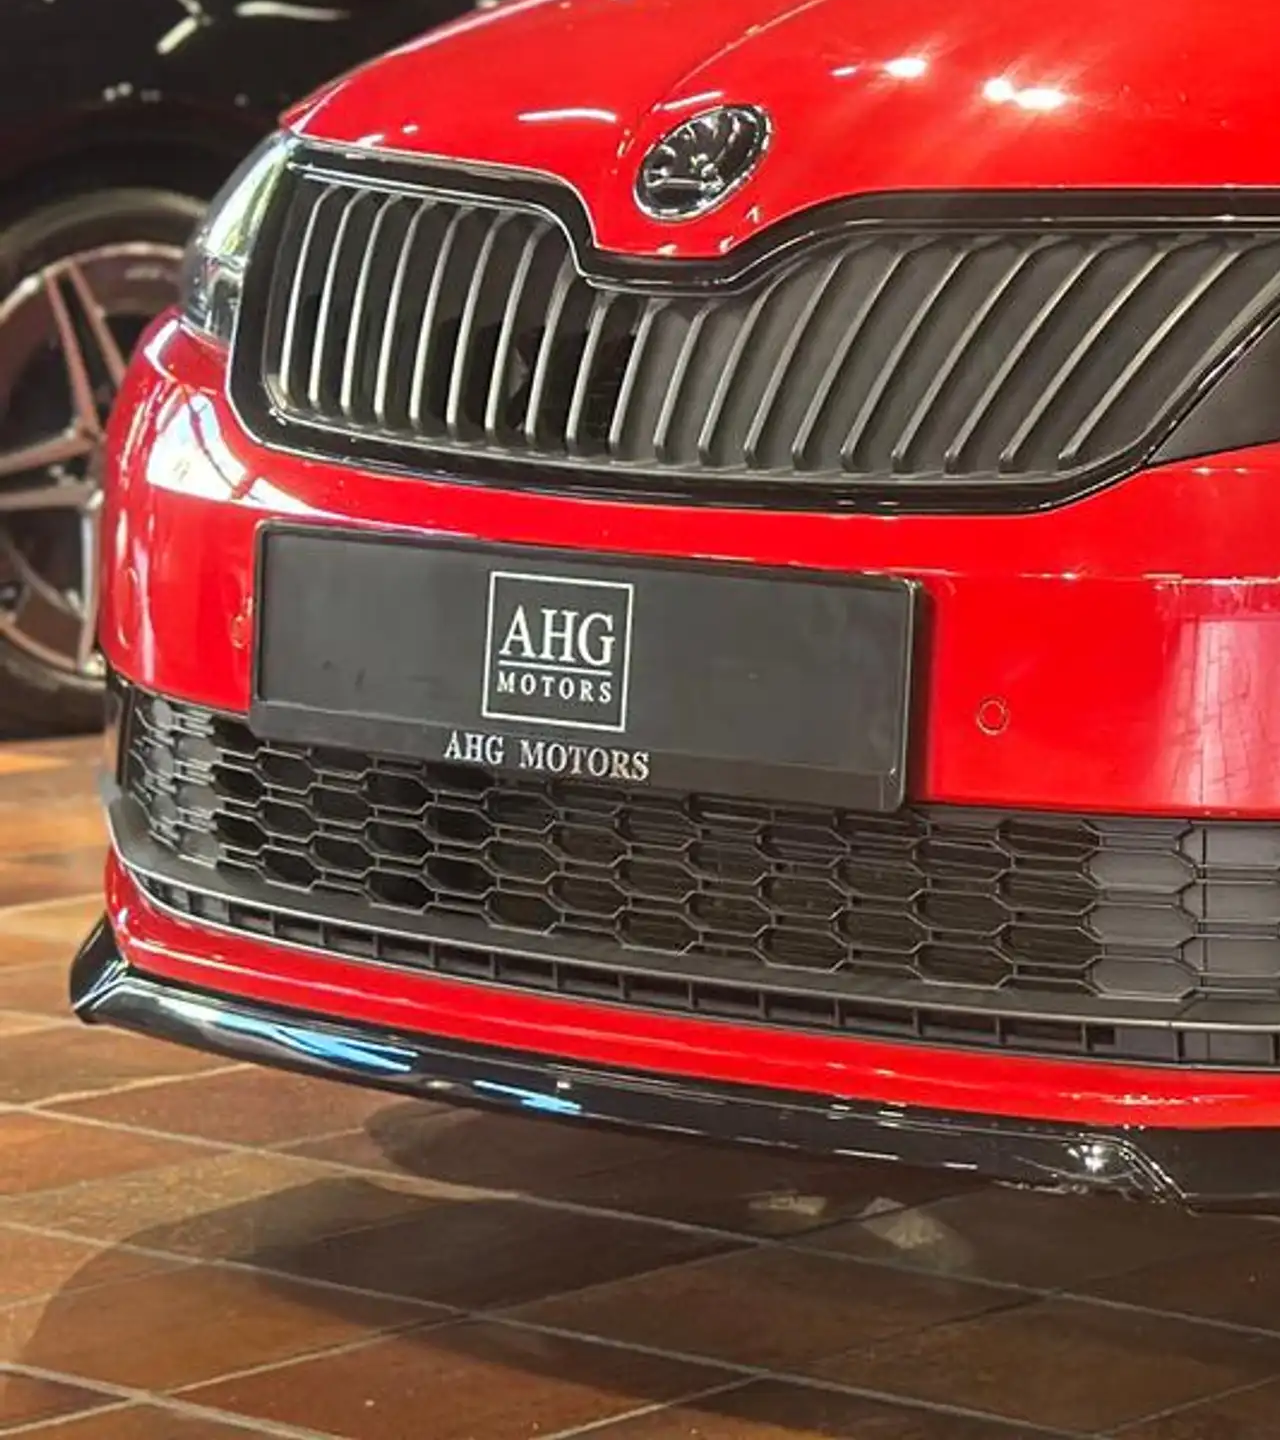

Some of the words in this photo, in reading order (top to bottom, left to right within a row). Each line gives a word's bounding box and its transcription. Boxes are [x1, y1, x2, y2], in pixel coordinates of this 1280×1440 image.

[498, 604, 616, 667] AHG
[496, 670, 613, 704] MOTORS
[443, 729, 505, 765] AHG
[518, 738, 651, 782] MOTORS
